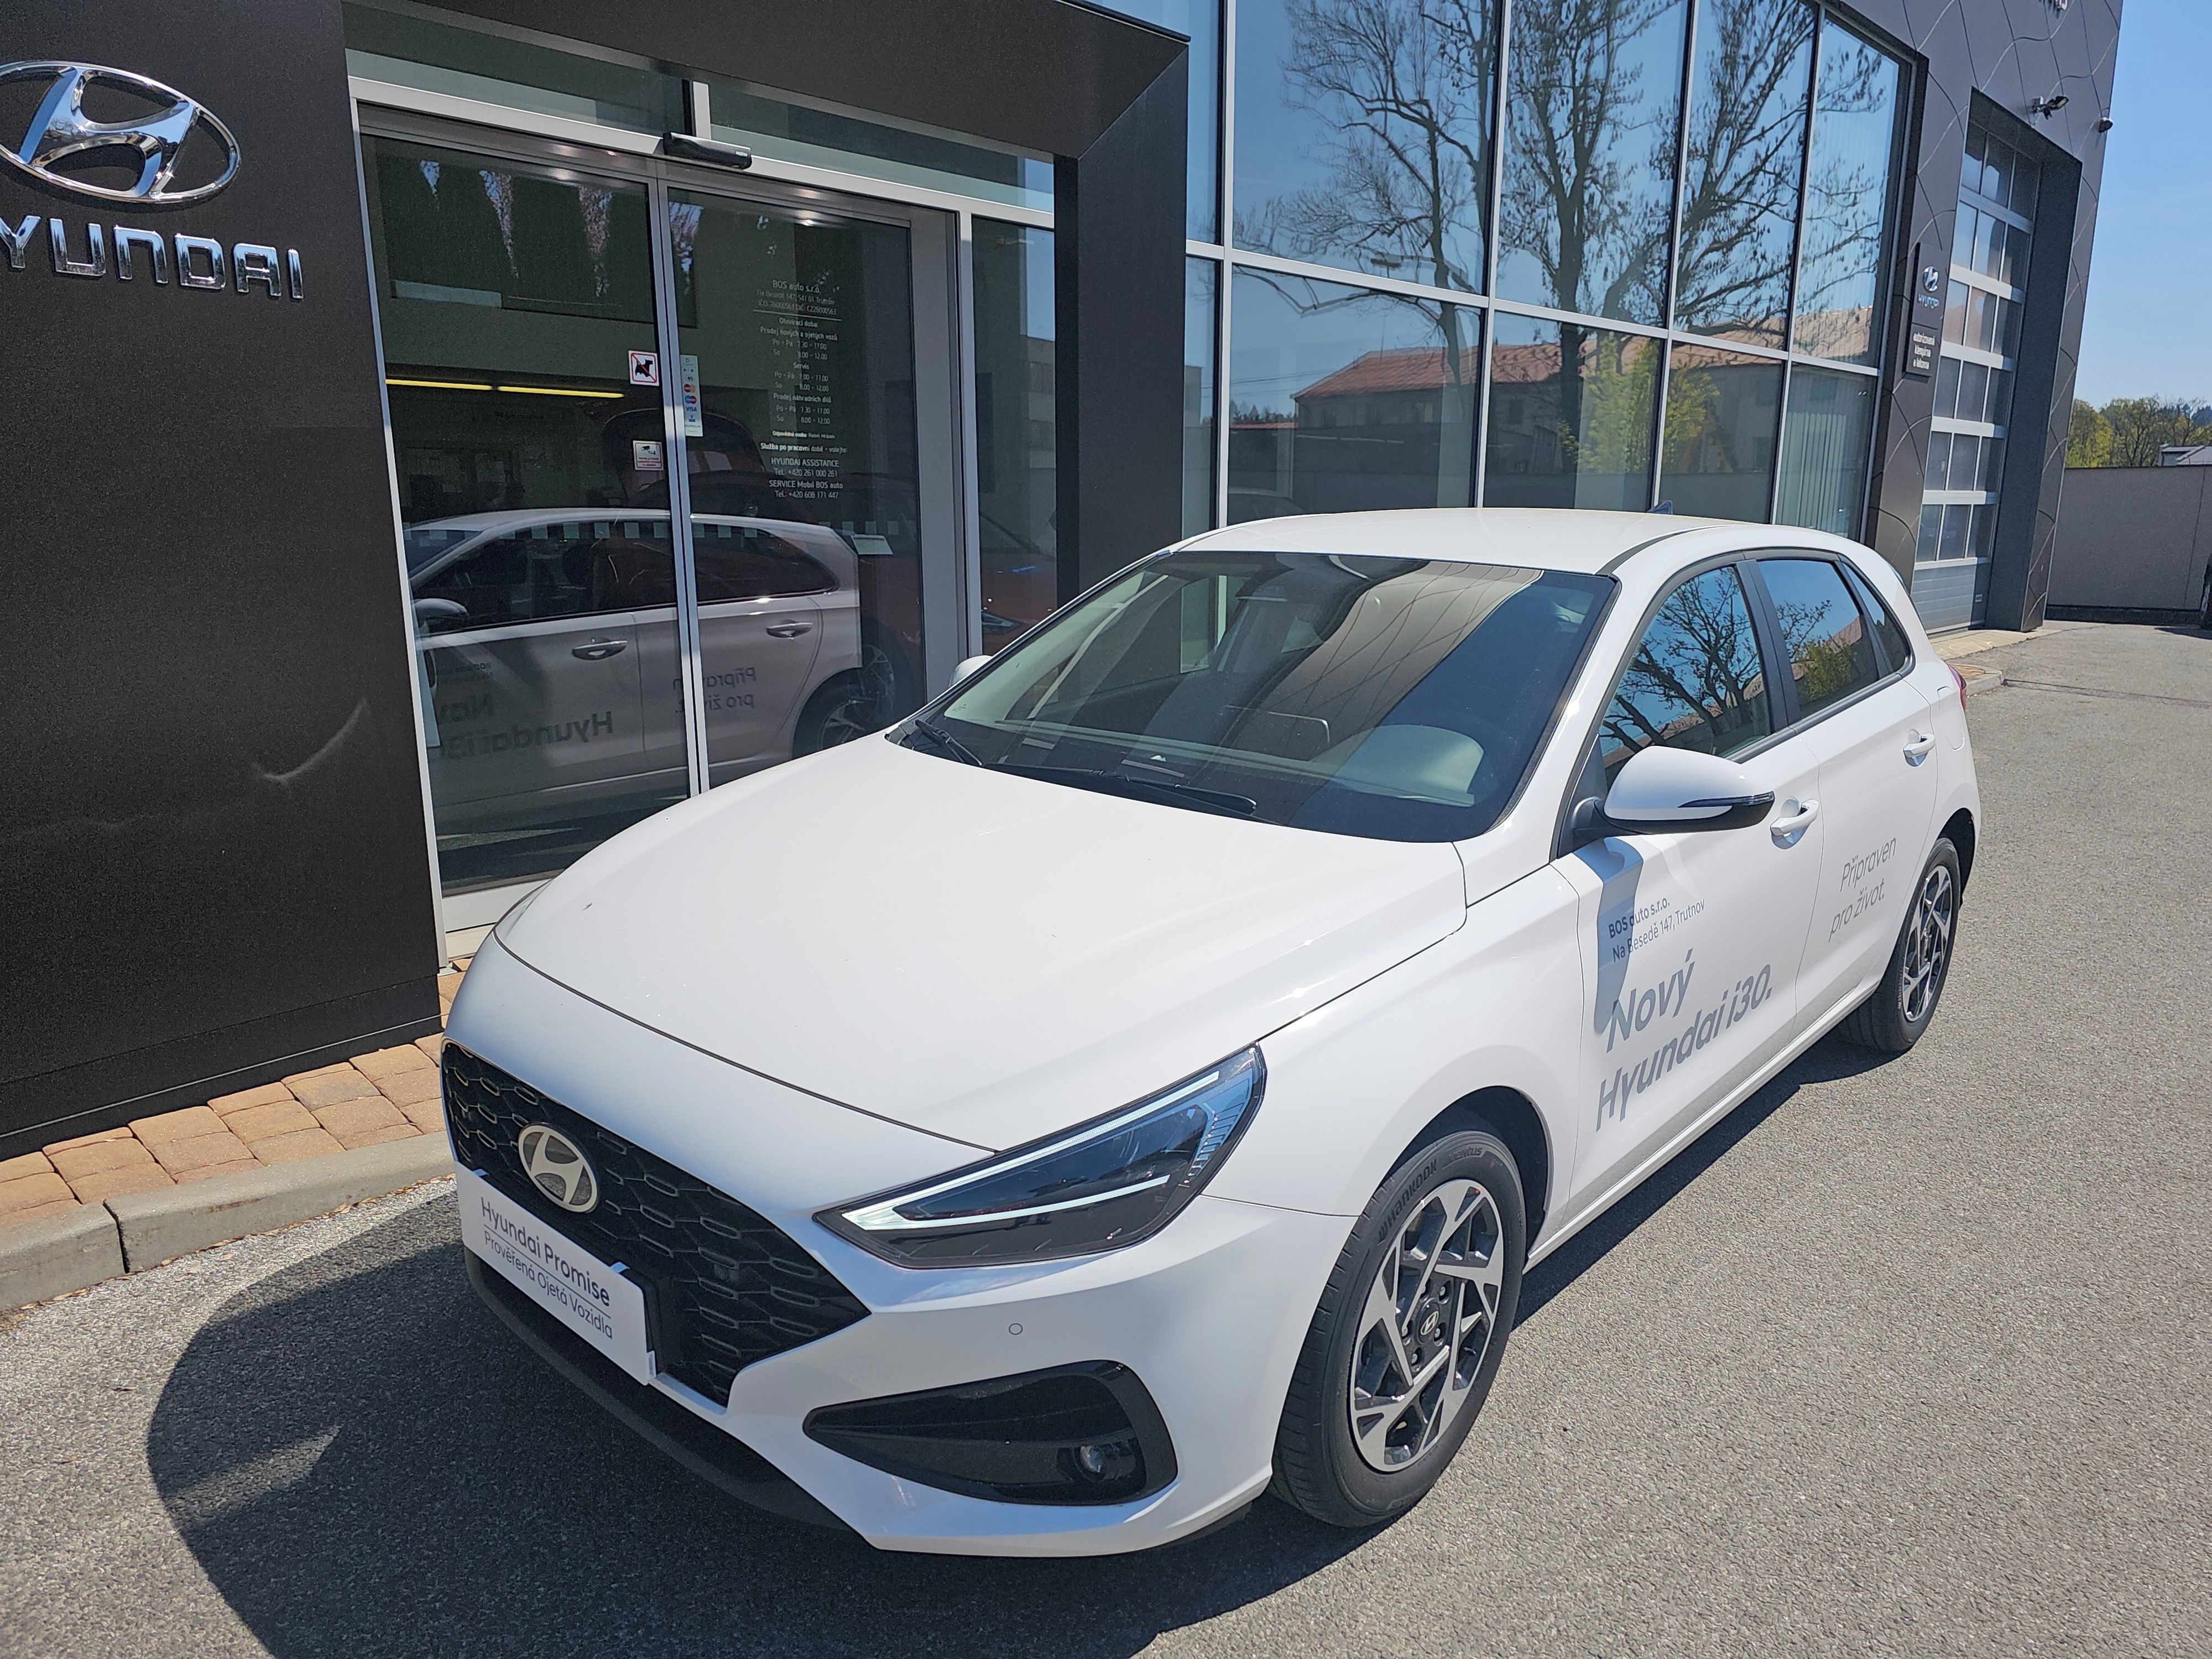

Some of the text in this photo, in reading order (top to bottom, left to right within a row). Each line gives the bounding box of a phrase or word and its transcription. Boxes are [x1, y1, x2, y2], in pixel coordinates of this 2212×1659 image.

[773, 280, 787, 289] BOS
[789, 283, 804, 291] auto
[760, 327, 779, 336] Prodej
[793, 362, 810, 370] Servis
[773, 393, 791, 401] Prodej
[771, 457, 839, 468] HYUNDAI ASSISTANCE
[787, 444, 810, 452] pracovní
[769, 480, 796, 488] SERVICE
[1840, 837, 1896, 892] Připraven
[1608, 898, 1670, 938] BOS auto s.r.o.
[1828, 878, 1885, 943] pro život.
[1613, 899, 1705, 963] Na Besedě 147, Trutnov
[1606, 947, 1695, 1053] Nový
[1596, 964, 1773, 1133] Hyundai i30.
[481, 1196, 610, 1307] Hyundai Promise
[484, 1230, 613, 1339] Prověřená Ojetá Vozidla
